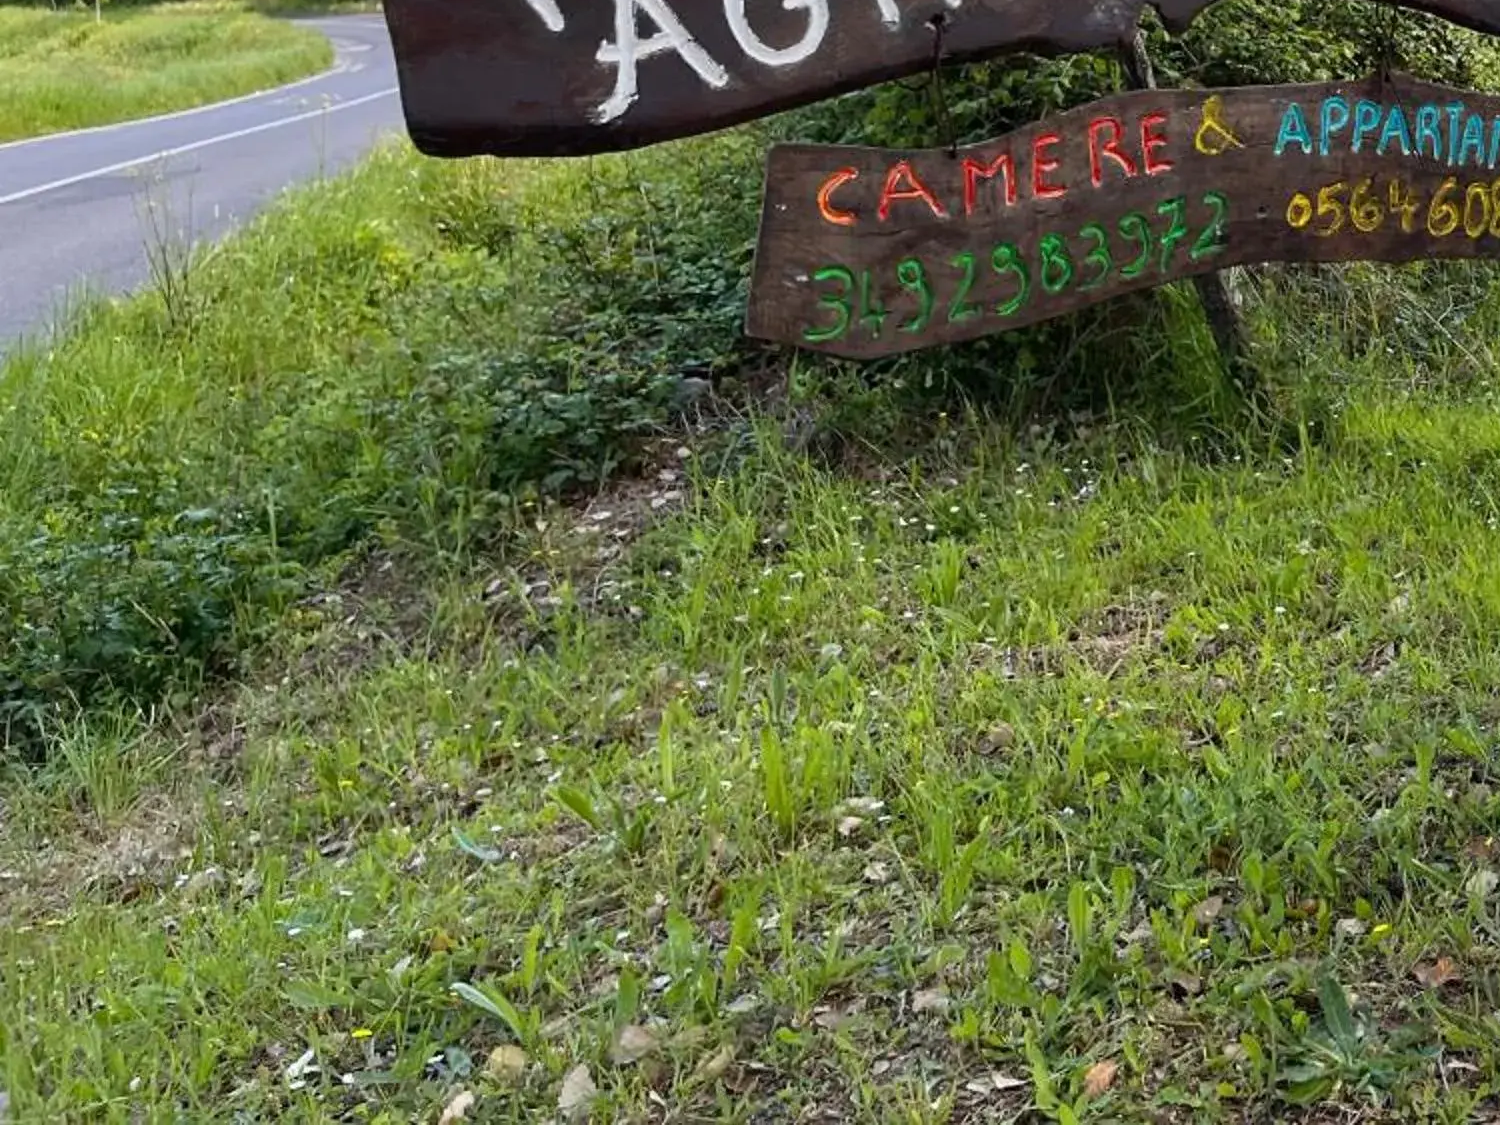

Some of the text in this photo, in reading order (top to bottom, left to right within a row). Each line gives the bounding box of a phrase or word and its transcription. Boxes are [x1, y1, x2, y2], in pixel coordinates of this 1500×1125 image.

[817, 110, 1174, 225] CAMERE
[1195, 94, 1245, 155] &
[803, 190, 1230, 341] 3492983972
